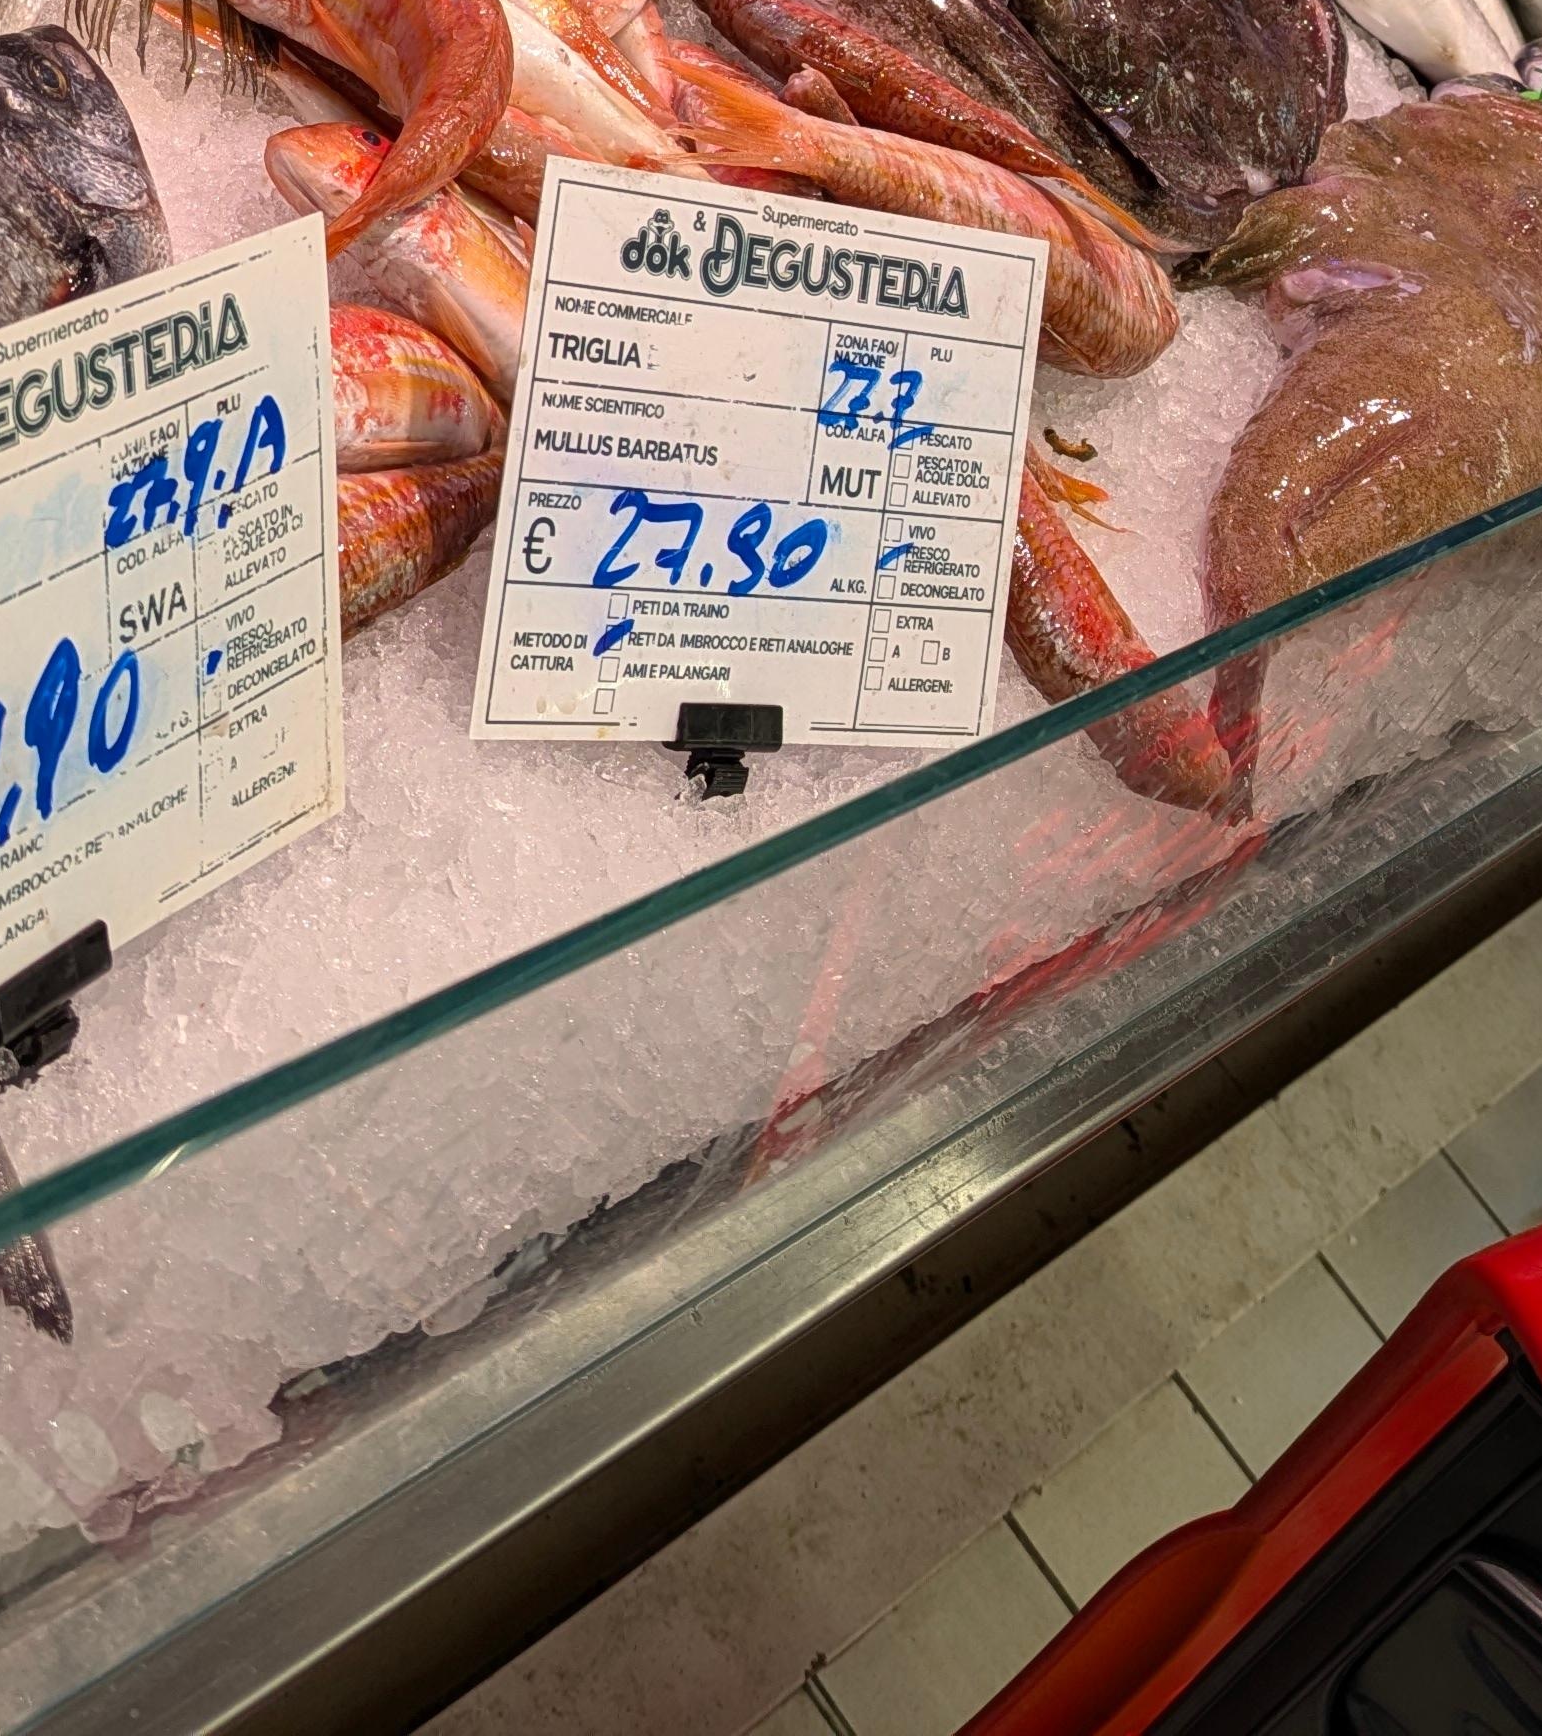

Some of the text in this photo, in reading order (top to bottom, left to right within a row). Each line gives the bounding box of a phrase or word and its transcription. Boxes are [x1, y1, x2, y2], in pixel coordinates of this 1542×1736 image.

[762, 205, 859, 237] Supermercato
[622, 233, 692, 281] dok
[693, 211, 707, 232] &
[555, 296, 693, 326] NOME COMMERCIALE
[548, 332, 641, 369] TRIGLIA
[835, 334, 899, 355] ZONA FAO/
[930, 347, 954, 363] PLU
[542, 393, 664, 418] NOME SCIENTIFICO
[534, 430, 719, 466] MULLUS BARBATUS
[820, 465, 883, 499] MUT
[528, 493, 581, 511] PREZZO
[912, 491, 971, 508] ALLEVATO
[523, 516, 556, 574] €
[831, 578, 867, 594] AL KG.
[901, 582, 985, 601] DECONGELATO
[119, 583, 188, 645] SWA
[680, 602, 729, 618] TRAINO
[896, 615, 934, 631] EXTRA
[514, 632, 588, 649] METODO DI
[680, 634, 747, 649] IMBROCCO
[510, 655, 574, 671] CATTURA
[658, 665, 730, 680] PALANGARI
[888, 676, 954, 694] ALLERGENI:
